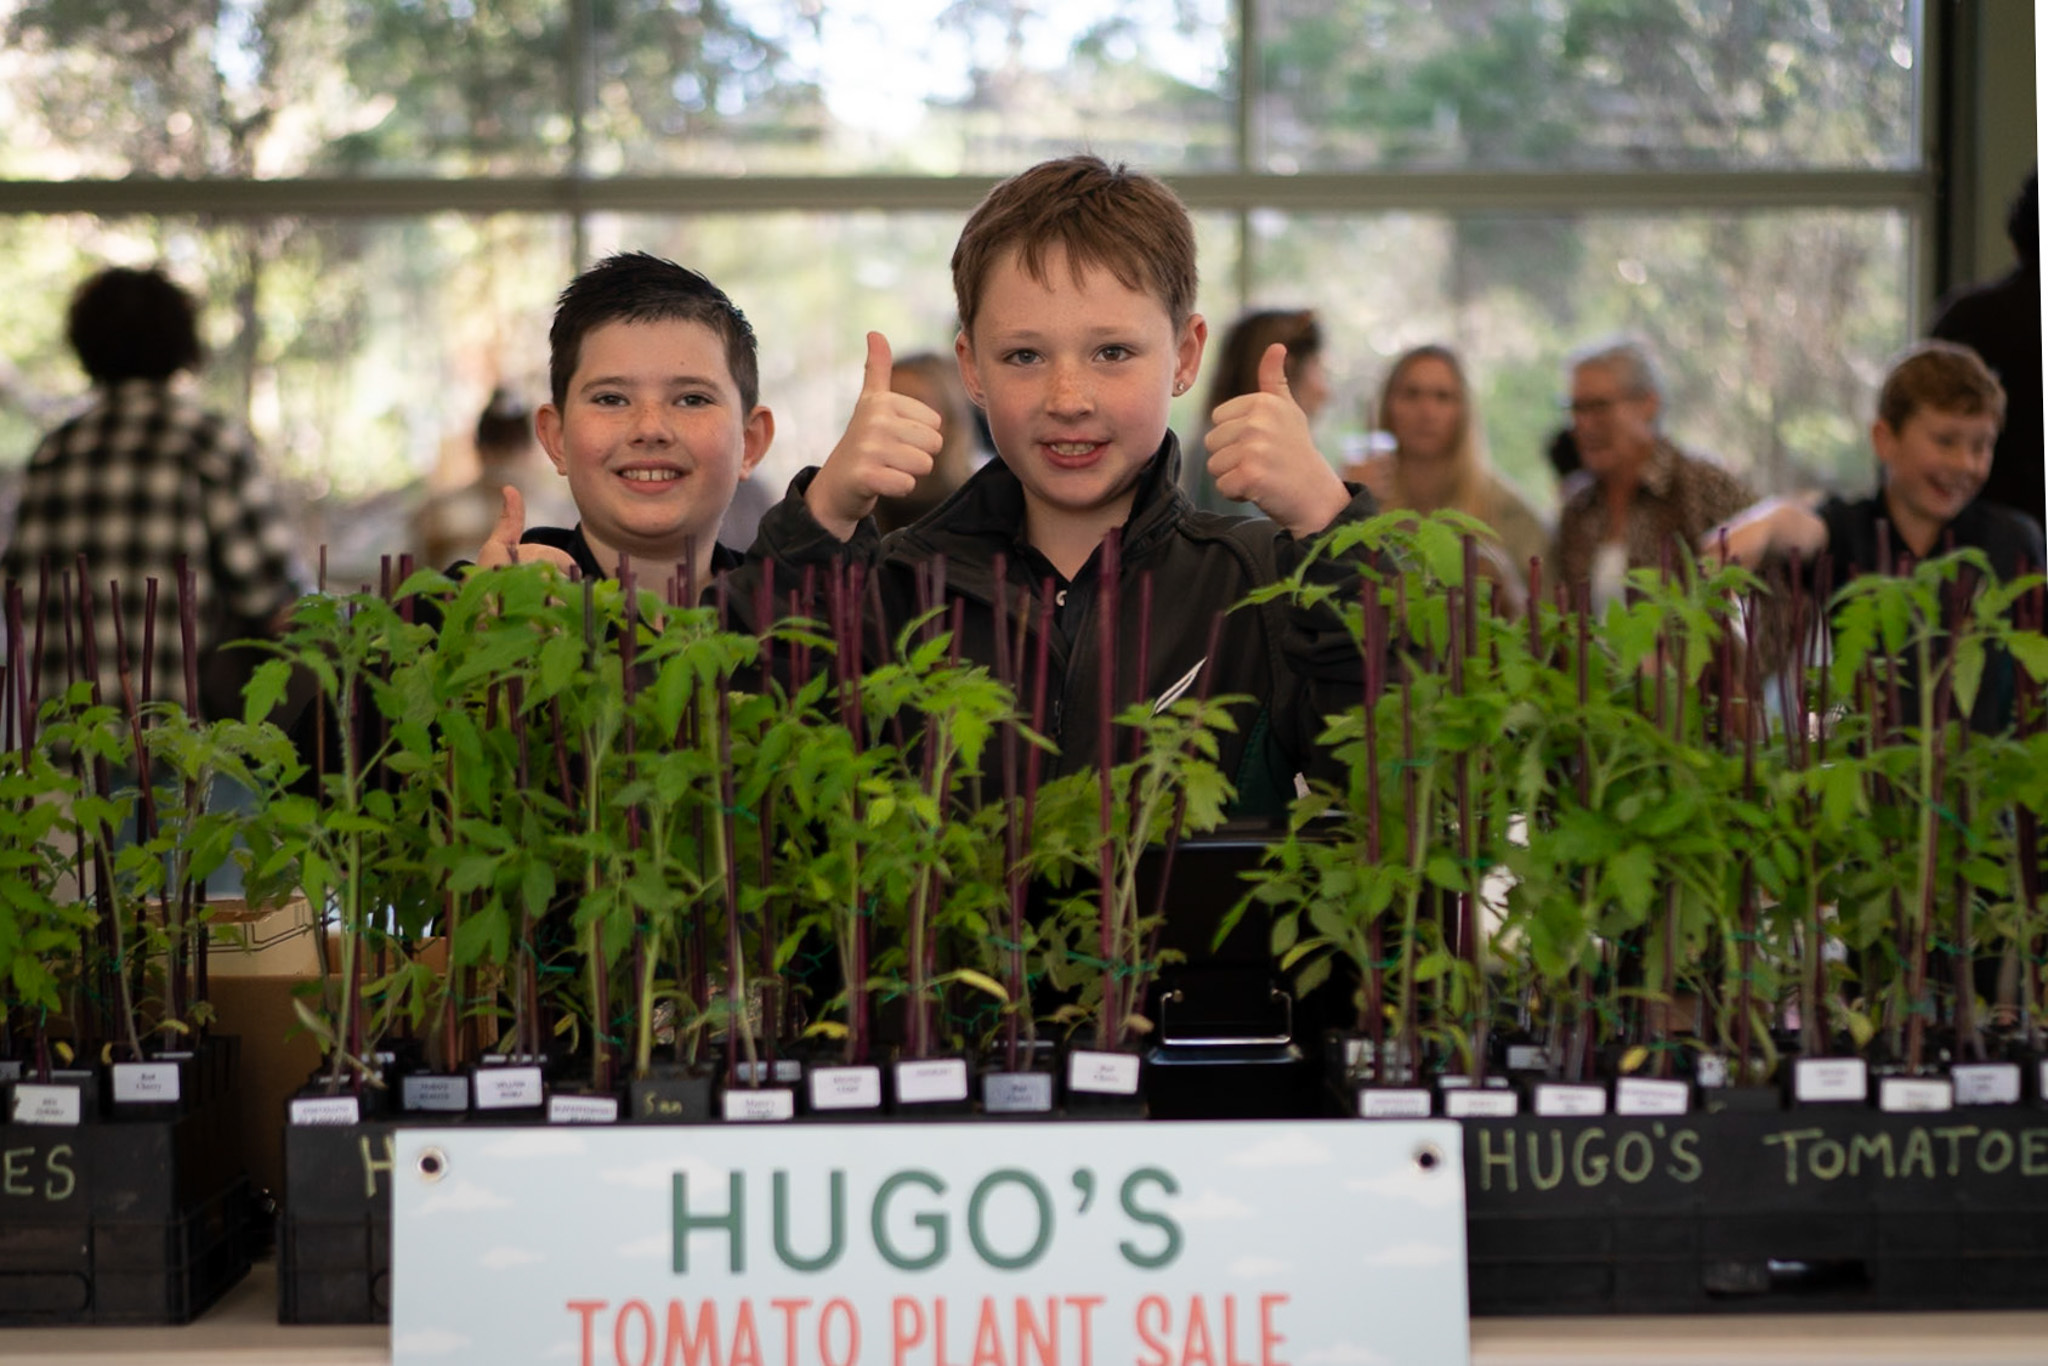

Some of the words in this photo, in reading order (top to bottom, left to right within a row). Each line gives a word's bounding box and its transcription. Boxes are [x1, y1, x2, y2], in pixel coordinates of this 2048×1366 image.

[3, 1144, 76, 1201] ES
[1480, 1124, 1702, 1191] HUGO'S
[671, 1167, 1186, 1275] HUGO’S
[566, 1297, 861, 1366] TOMATO
[890, 1295, 1105, 1366] PLANT
[1134, 1293, 1291, 1366] SALE
